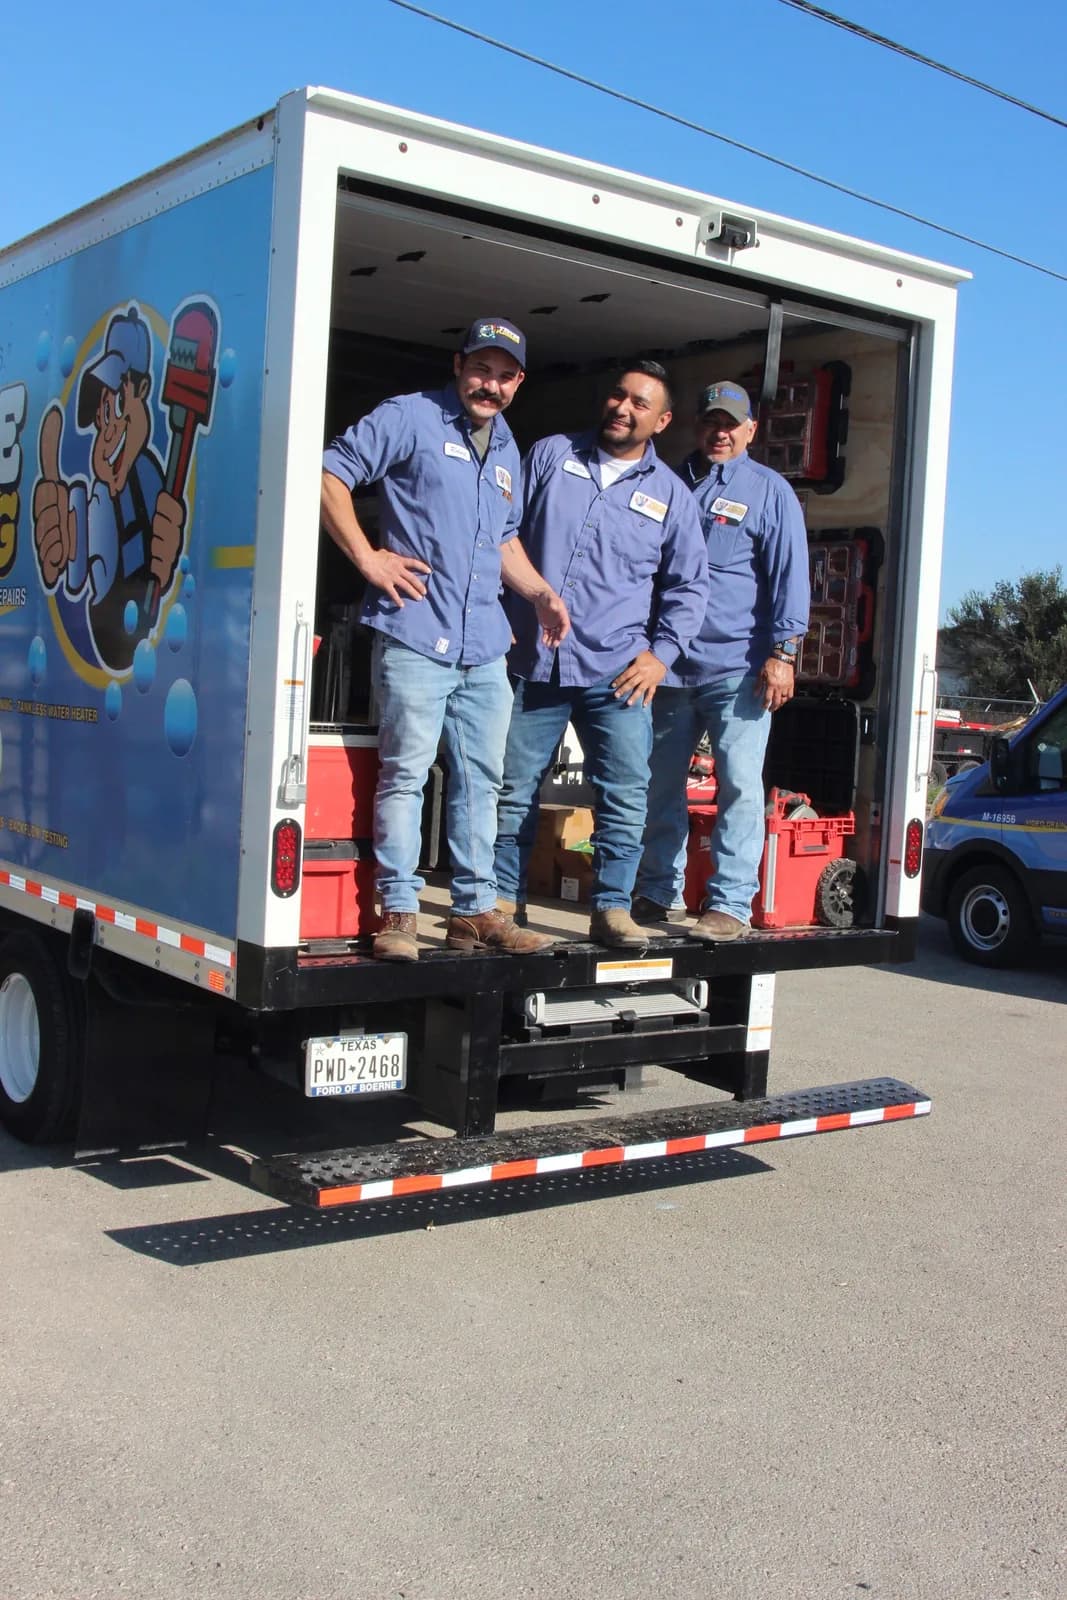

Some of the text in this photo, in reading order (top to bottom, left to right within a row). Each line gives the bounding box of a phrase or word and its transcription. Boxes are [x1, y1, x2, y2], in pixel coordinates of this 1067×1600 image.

[16, 700, 47, 717] TANKLESS
[48, 703, 70, 720] WATER
[71, 706, 97, 722] HEATER
[42, 829, 69, 848] TESTING
[340, 1040, 377, 1052] TEXAS
[316, 1081, 397, 1096] FORD OF BOERNE
